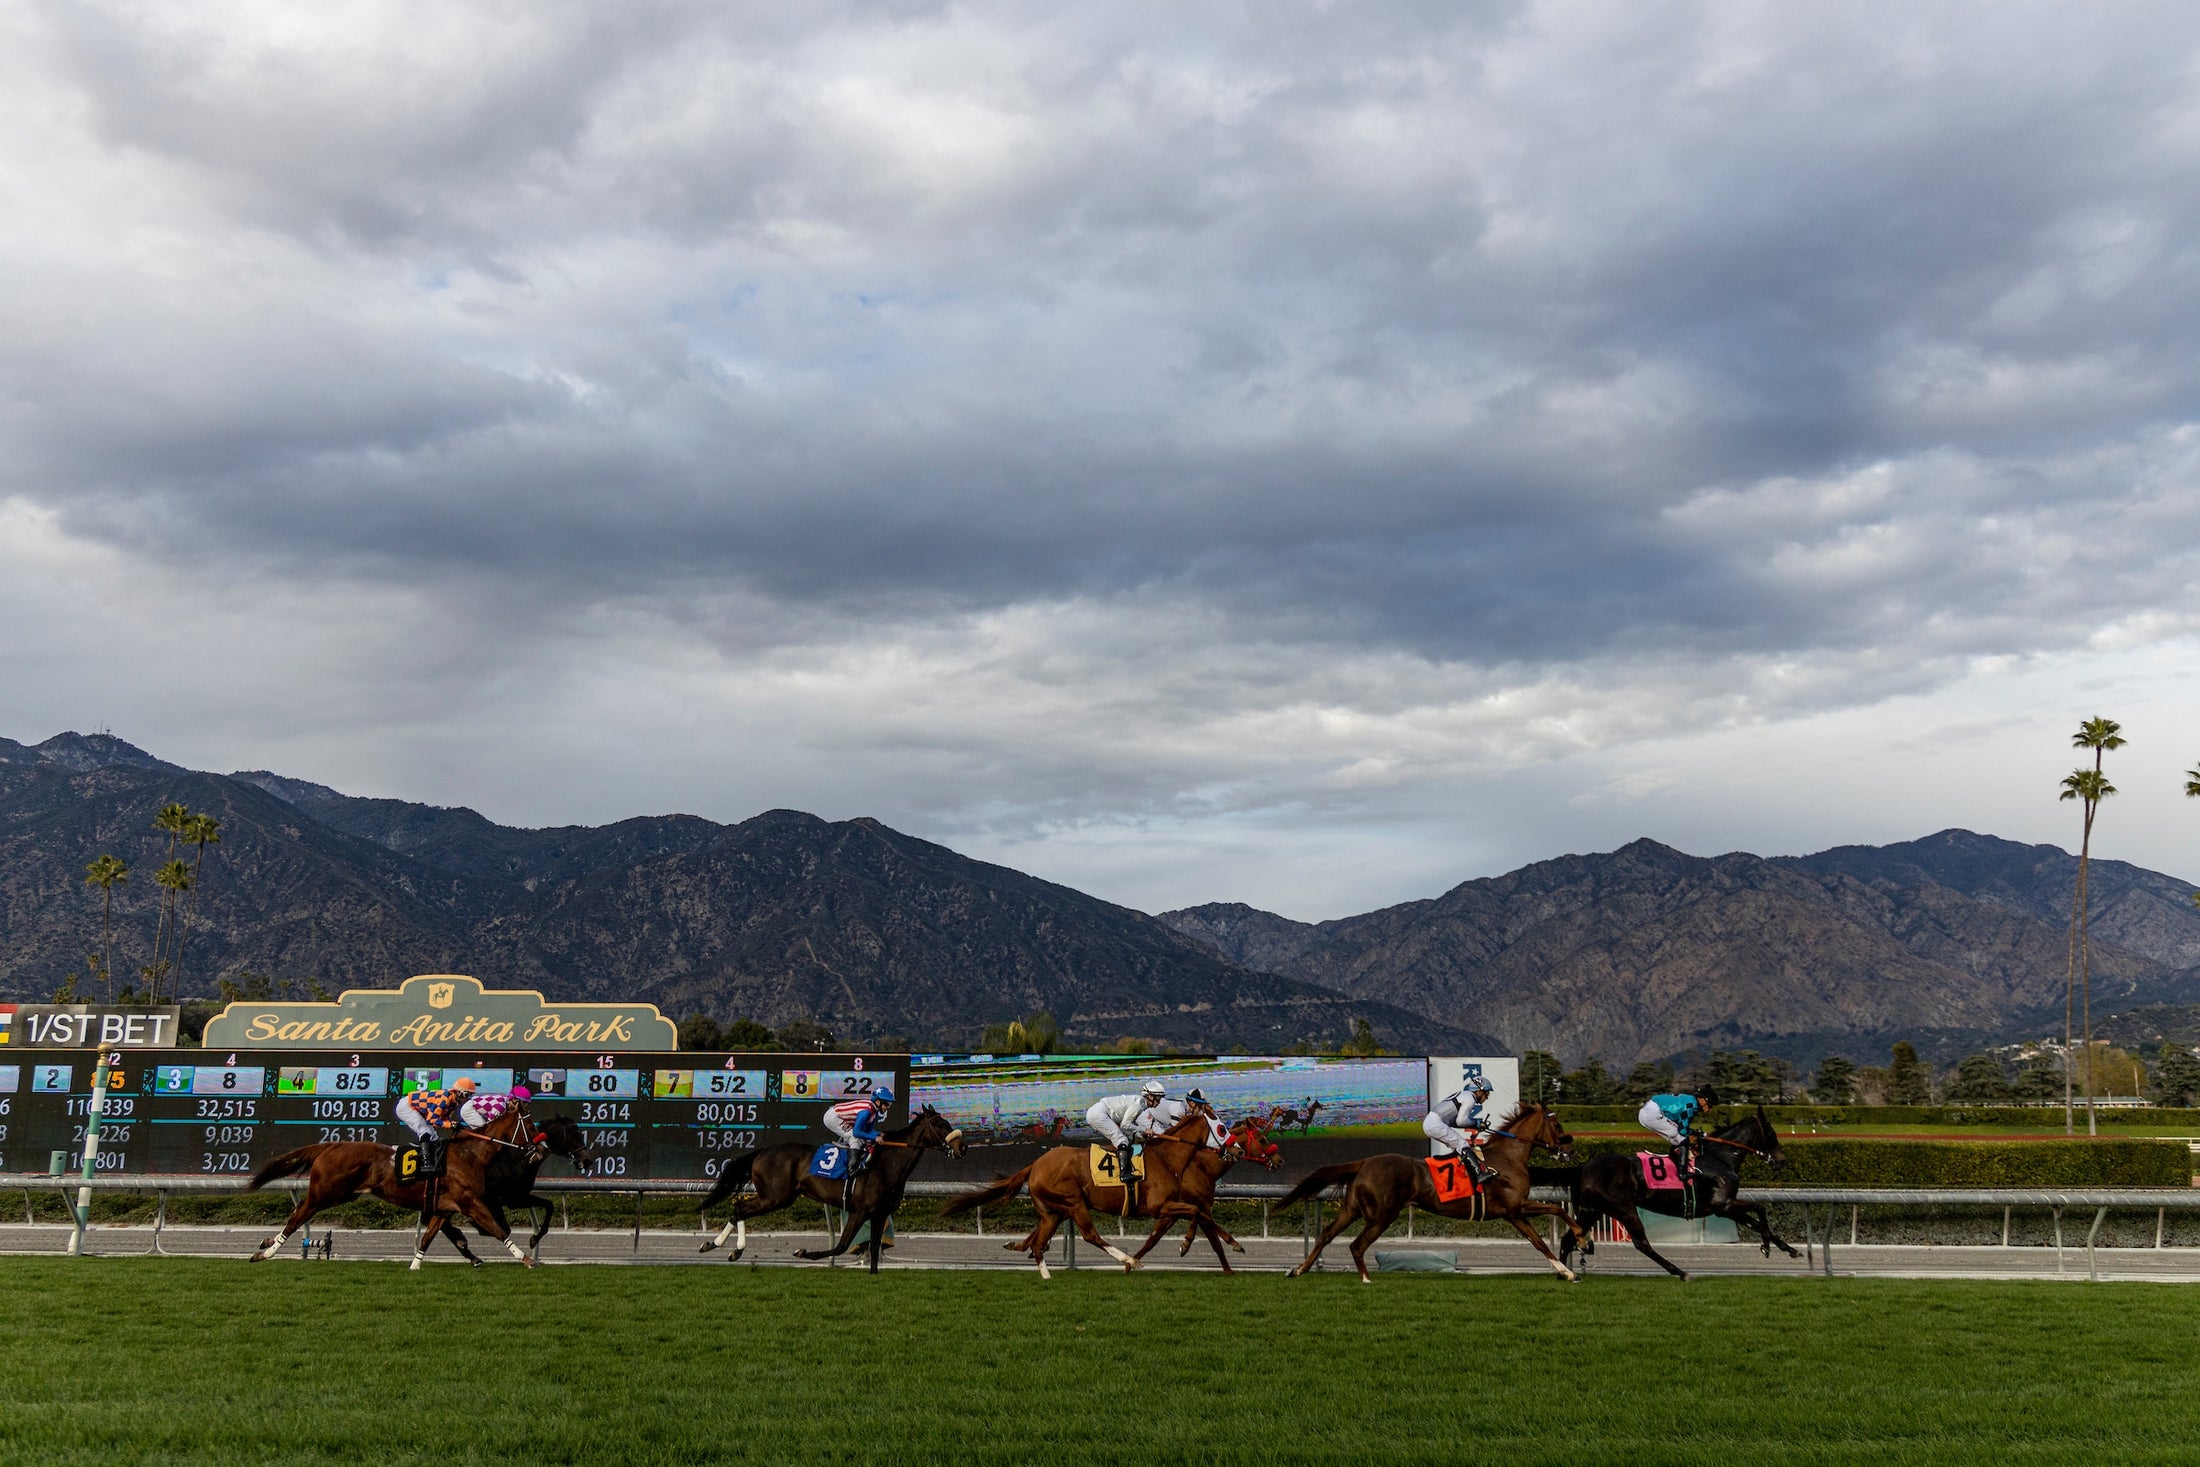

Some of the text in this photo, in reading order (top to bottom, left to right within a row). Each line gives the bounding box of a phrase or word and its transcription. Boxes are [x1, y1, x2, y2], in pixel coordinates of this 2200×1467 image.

[27, 1014, 171, 1043] 1/ST BET
[246, 1014, 632, 1046] Santa Anita Park
[226, 1054, 236, 1067] 4
[350, 1054, 360, 1067] 3
[597, 1056, 614, 1069] 15
[725, 1057, 735, 1070] 4
[854, 1058, 863, 1071] 8
[46, 1068, 59, 1089] 2
[168, 1069, 181, 1090] 3
[222, 1072, 236, 1090] 8
[291, 1070, 304, 1091] 4
[335, 1073, 370, 1091] 8/5
[416, 1070, 429, 1091] 5
[541, 1072, 554, 1093] 6
[588, 1075, 617, 1092] 80
[668, 1073, 680, 1094] 7
[710, 1076, 746, 1093] 5/2
[795, 1074, 808, 1095] 8
[843, 1077, 873, 1095] 22
[66, 1099, 134, 1116] 11339
[197, 1100, 256, 1120] 32,515
[312, 1101, 380, 1120] 109,183
[581, 1103, 630, 1122] 3,614
[697, 1104, 757, 1124] 80,015
[72, 1125, 130, 1142] 2226
[205, 1127, 253, 1146] 9,039
[319, 1127, 377, 1143] 26313
[581, 1130, 628, 1149] 1,464
[697, 1132, 755, 1151] 15,842
[71, 1152, 126, 1169] 1801
[202, 1153, 250, 1174] 3,702
[402, 1150, 417, 1175] 6
[582, 1156, 626, 1177] ,103
[819, 1147, 839, 1170] 3
[1098, 1153, 1115, 1177] 4
[1437, 1163, 1454, 1192] 7
[1649, 1157, 1667, 1181] 8
